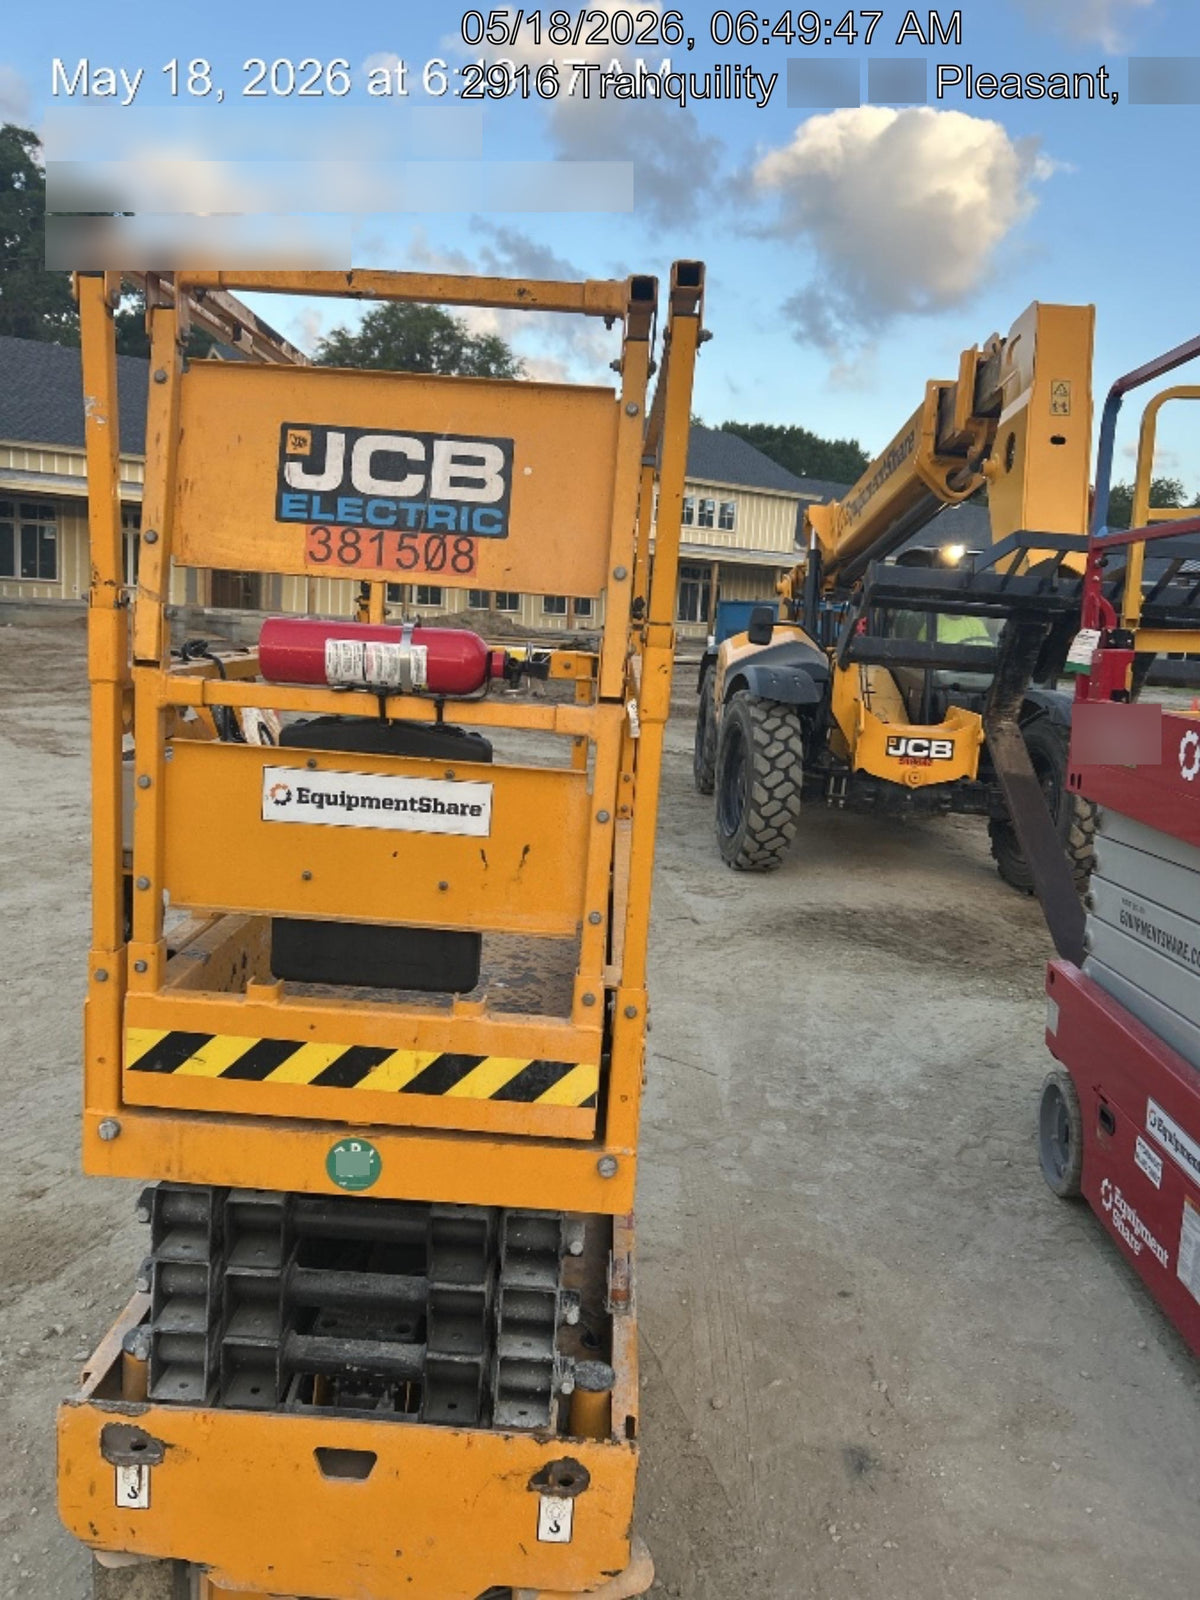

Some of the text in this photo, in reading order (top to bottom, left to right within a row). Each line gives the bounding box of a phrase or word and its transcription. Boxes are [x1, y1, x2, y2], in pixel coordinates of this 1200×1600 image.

[284, 431, 506, 503] JCB
[281, 493, 505, 534] ELECTRIC
[308, 526, 475, 574] 381508
[888, 738, 953, 759] JCB
[296, 787, 483, 817] EquipmentShare
